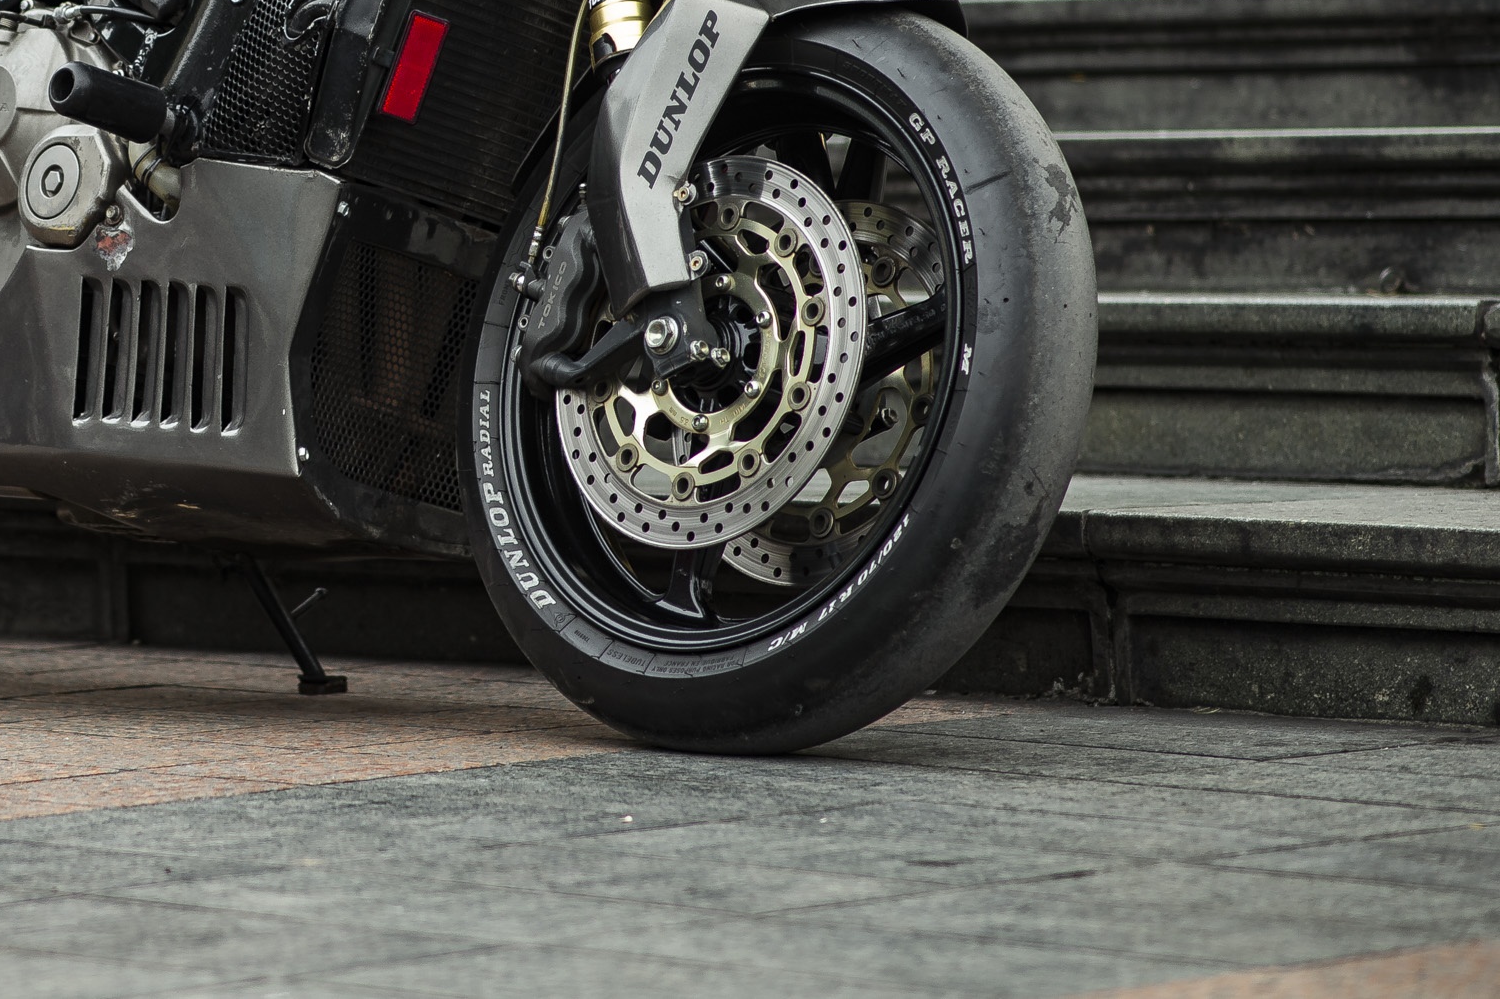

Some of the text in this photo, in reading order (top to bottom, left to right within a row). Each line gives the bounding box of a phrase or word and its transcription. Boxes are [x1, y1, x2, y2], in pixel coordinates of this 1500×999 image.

[637, 9, 720, 190] DUNLOP
[908, 112, 973, 265] GP RACER
[538, 261, 567, 329] TOKICO
[479, 389, 557, 610] DUNLOP RADIAL
[857, 513, 910, 586] 120/70
[767, 621, 809, 652] M/C
